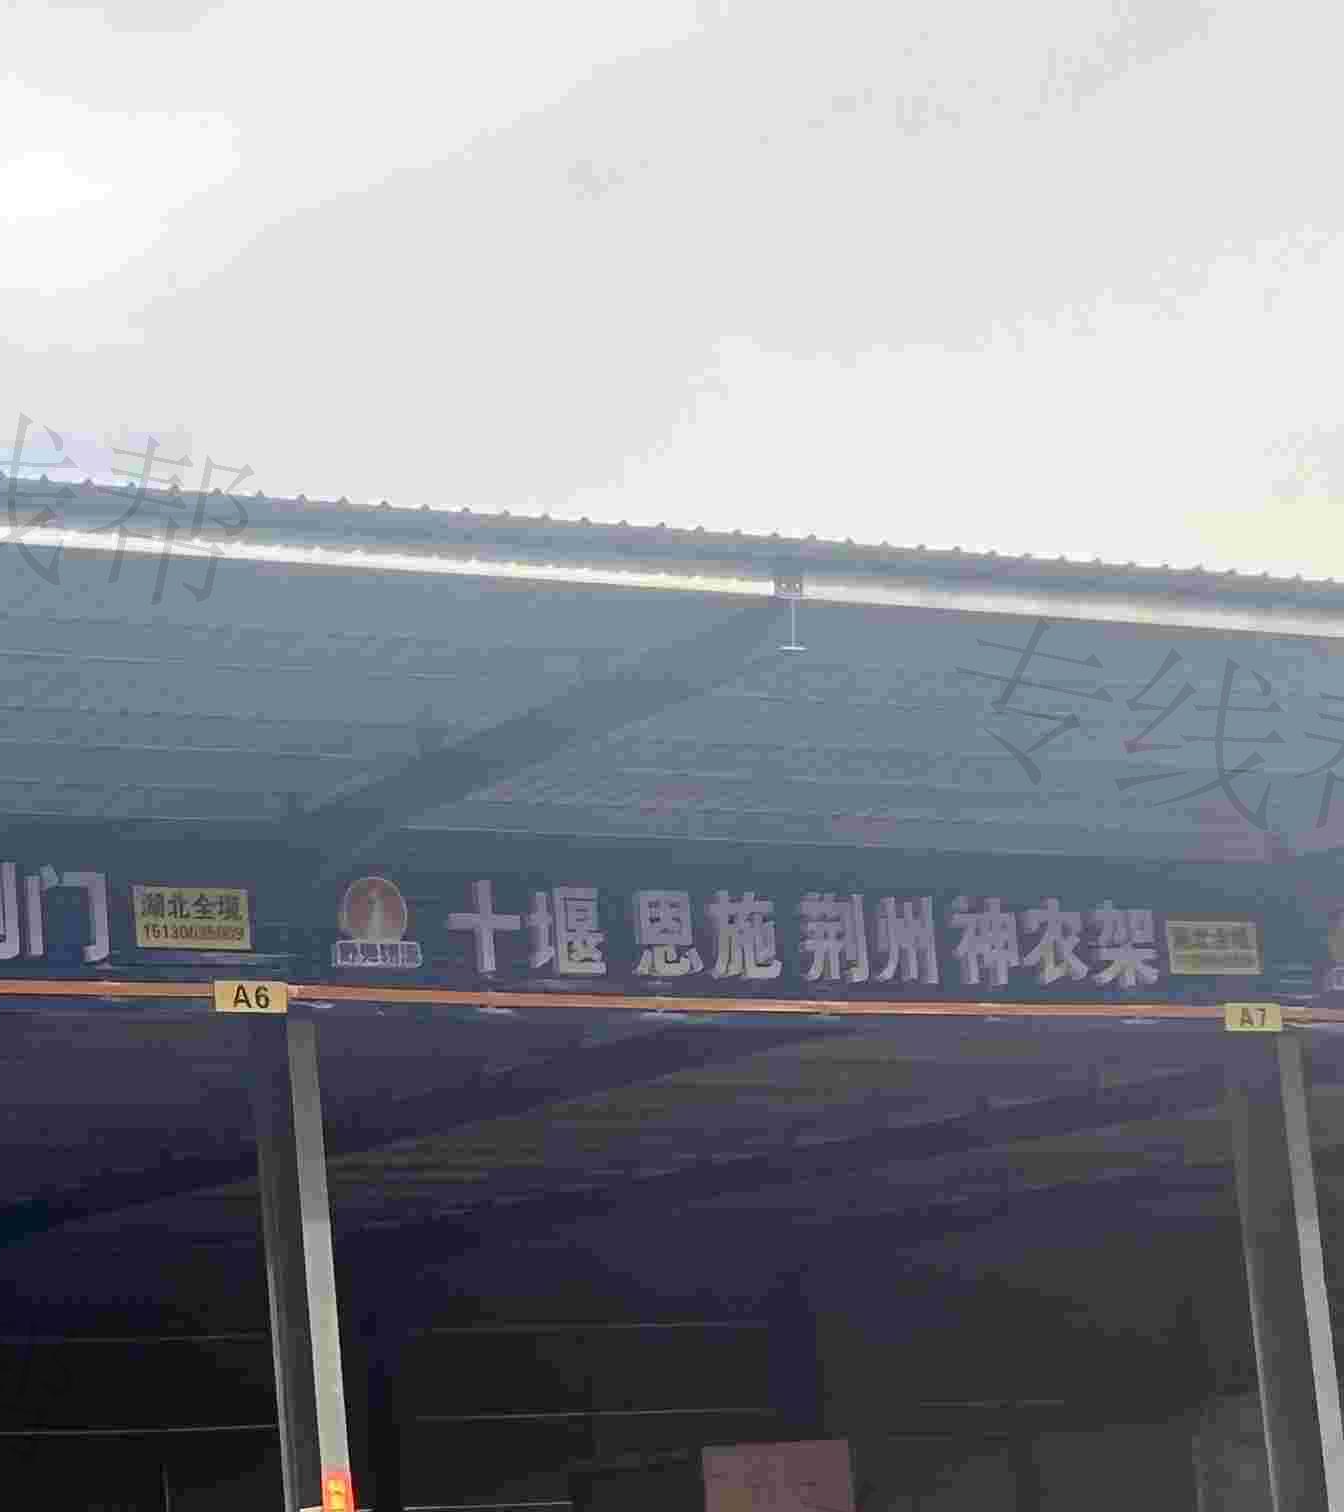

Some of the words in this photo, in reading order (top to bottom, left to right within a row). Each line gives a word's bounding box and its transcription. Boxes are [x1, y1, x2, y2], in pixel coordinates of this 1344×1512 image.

[445, 880, 608, 977] 十堰
[632, 889, 784, 980] 恩施
[799, 892, 940, 984] 荆州
[950, 898, 1160, 988] 神农架
[232, 985, 270, 1009] A6
